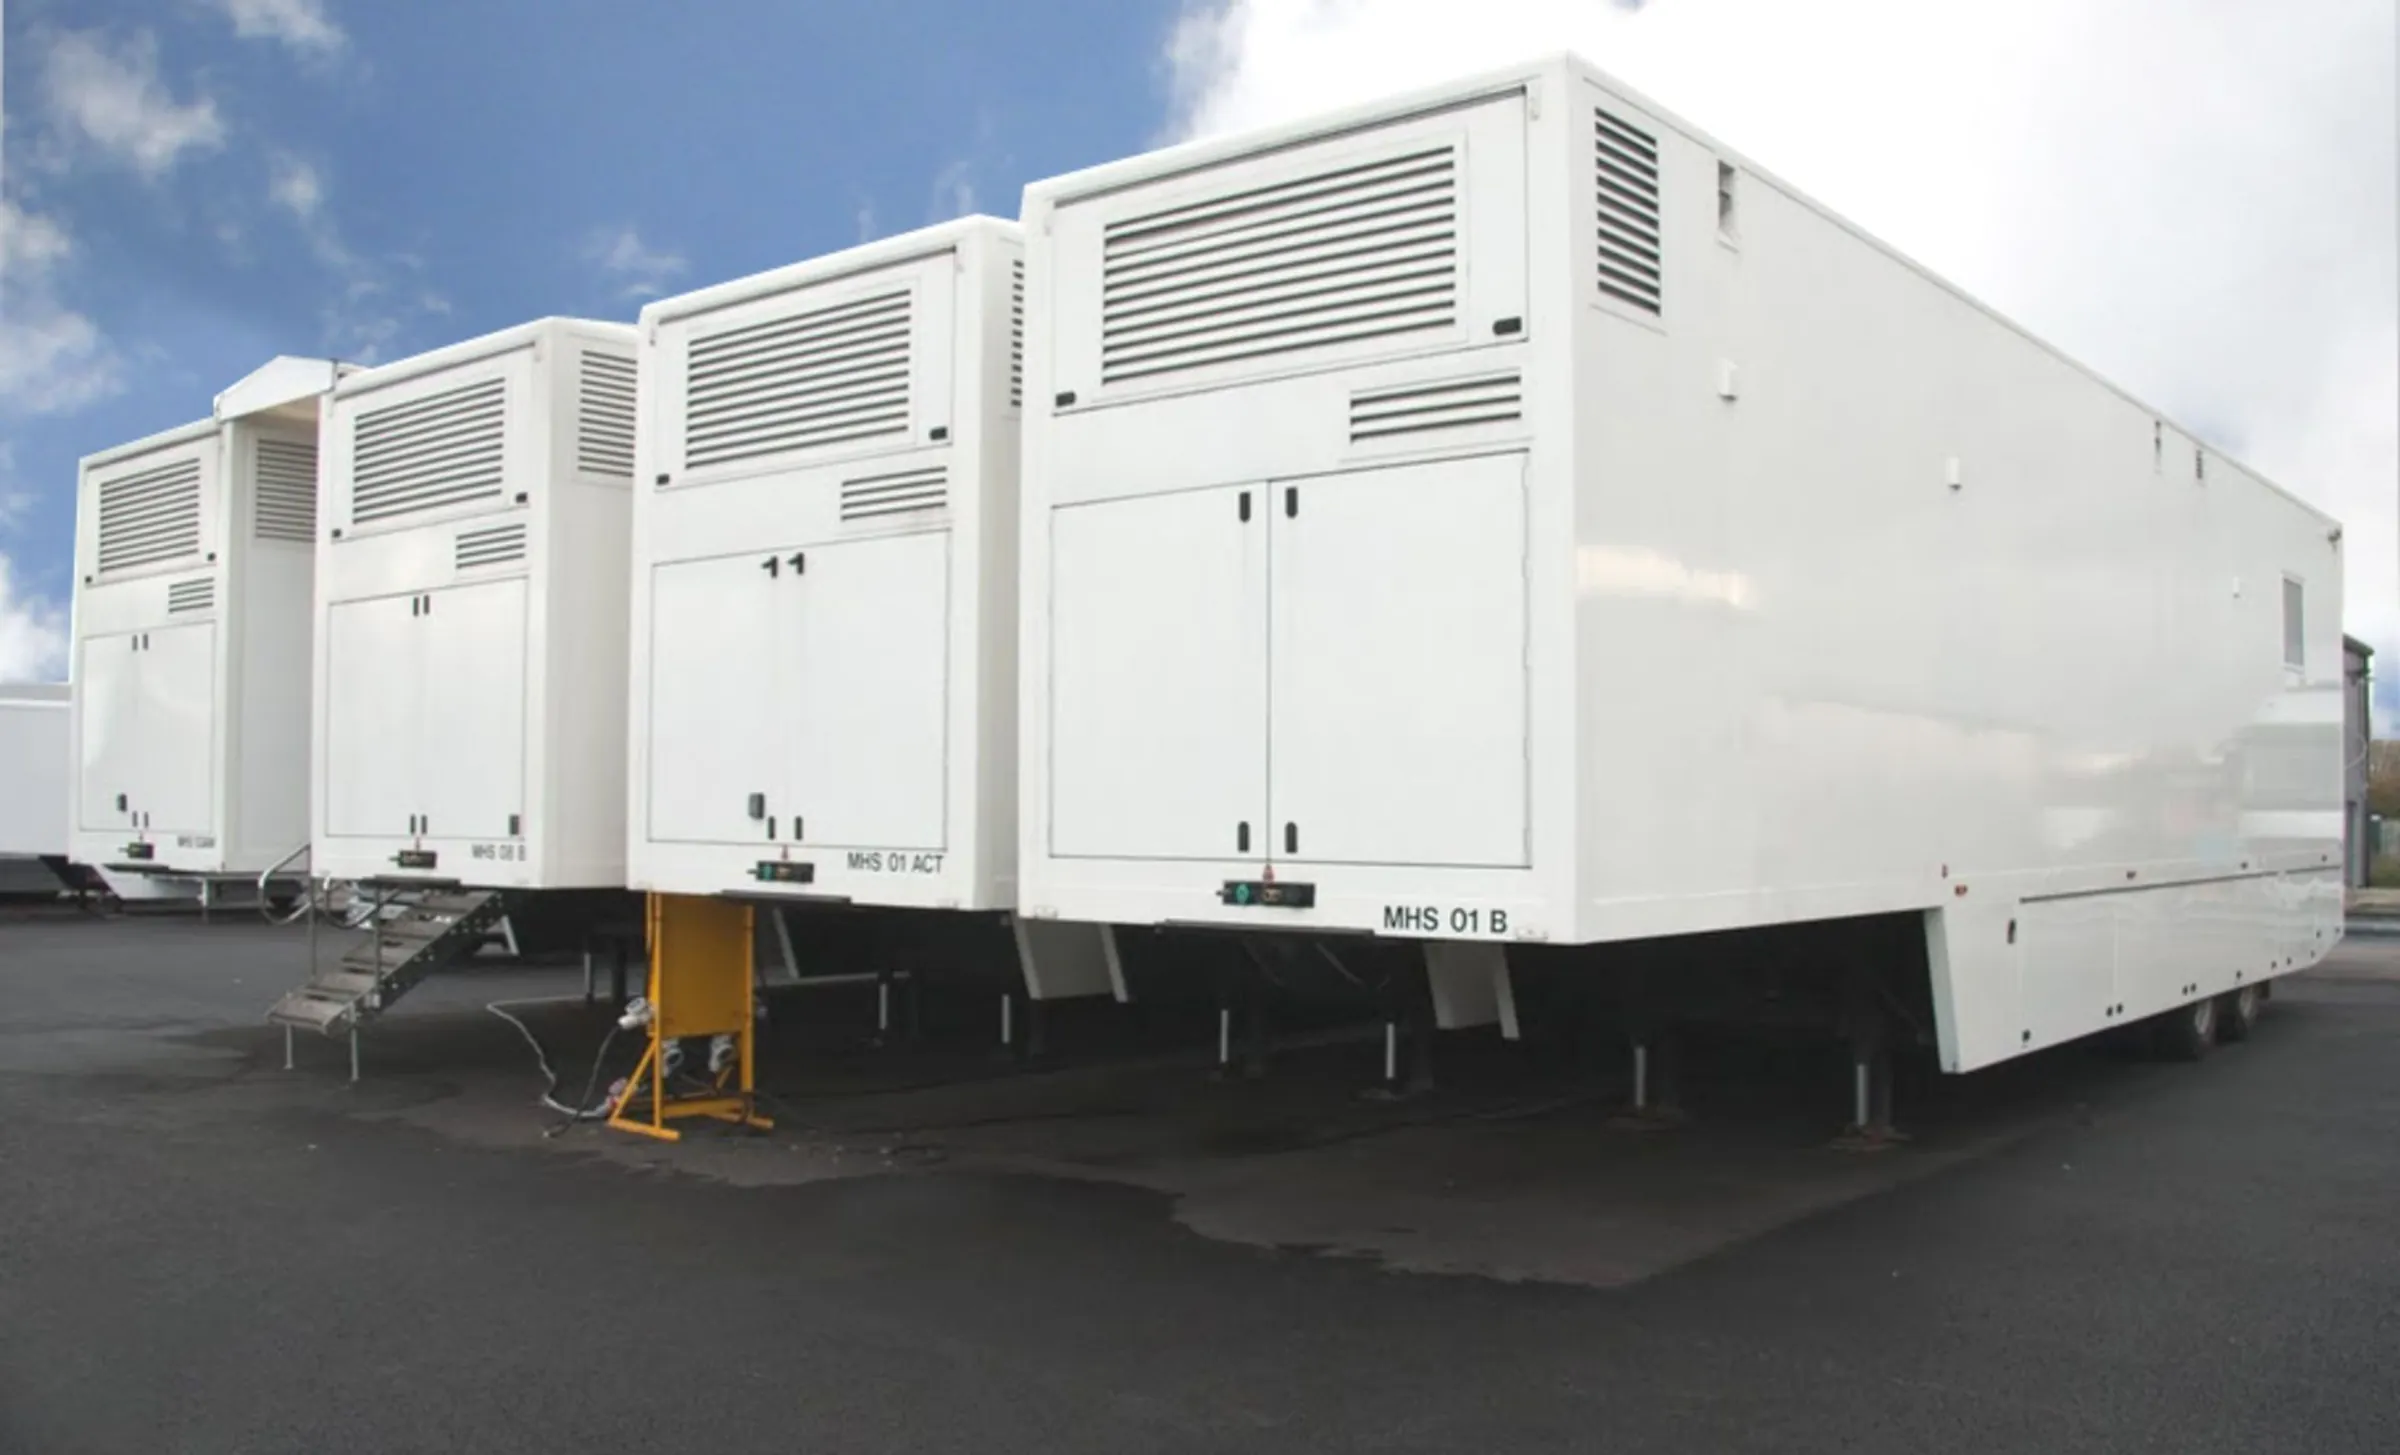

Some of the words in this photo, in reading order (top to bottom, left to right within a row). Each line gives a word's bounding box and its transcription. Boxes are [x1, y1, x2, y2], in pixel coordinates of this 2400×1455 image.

[847, 852, 882, 872] MHS
[888, 852, 906, 872] 01
[911, 854, 944, 874] ACT
[1383, 905, 1439, 932] MHS
[1450, 907, 1479, 933] 01
[1490, 909, 1508, 934] B
